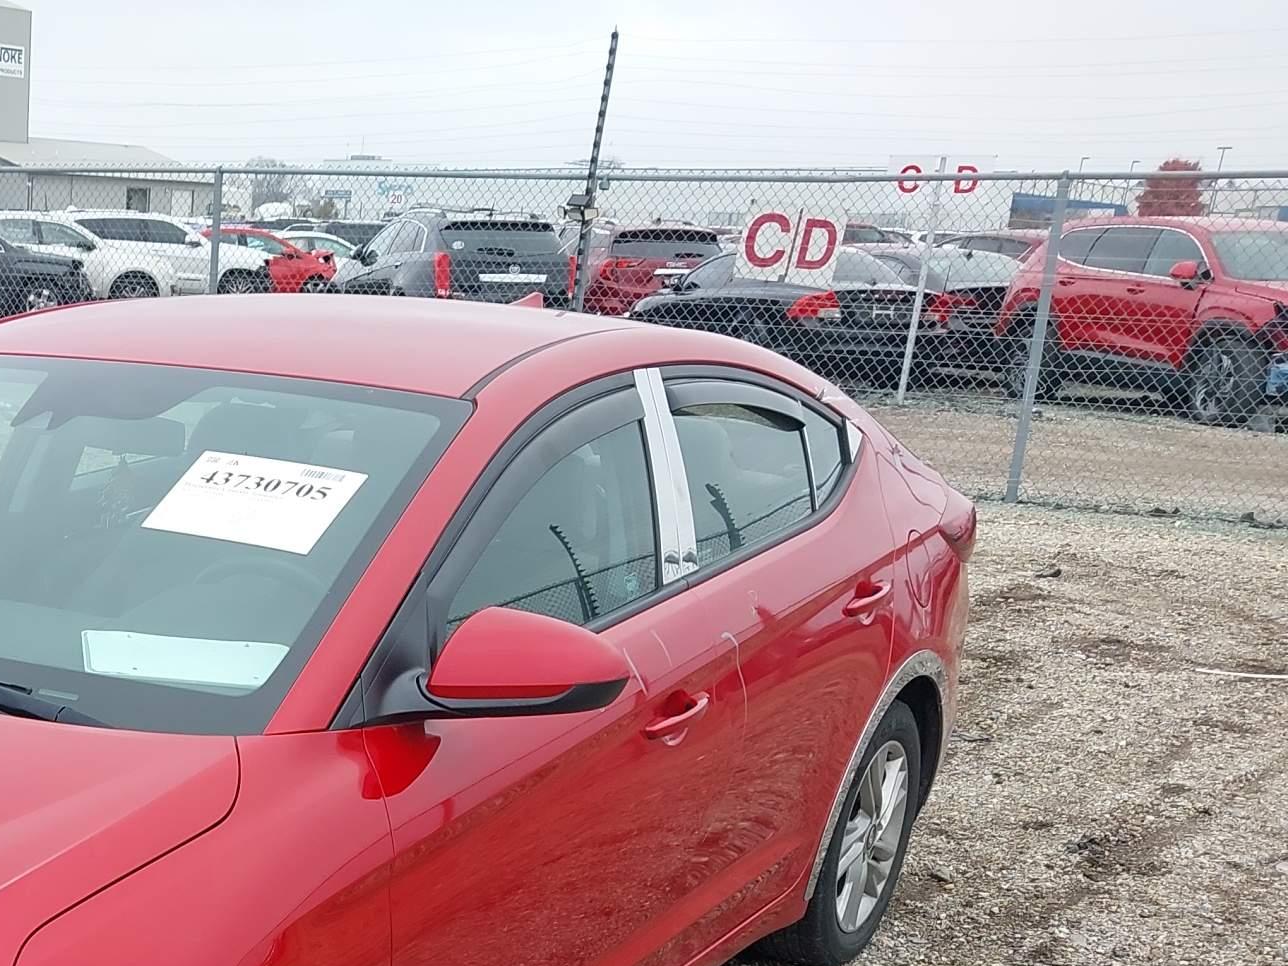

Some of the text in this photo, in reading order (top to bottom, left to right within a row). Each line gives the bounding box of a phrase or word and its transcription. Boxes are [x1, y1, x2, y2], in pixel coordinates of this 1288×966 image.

[896, 164, 980, 194] C D
[390, 192, 403, 204] 20
[200, 470, 333, 502] 43730705
